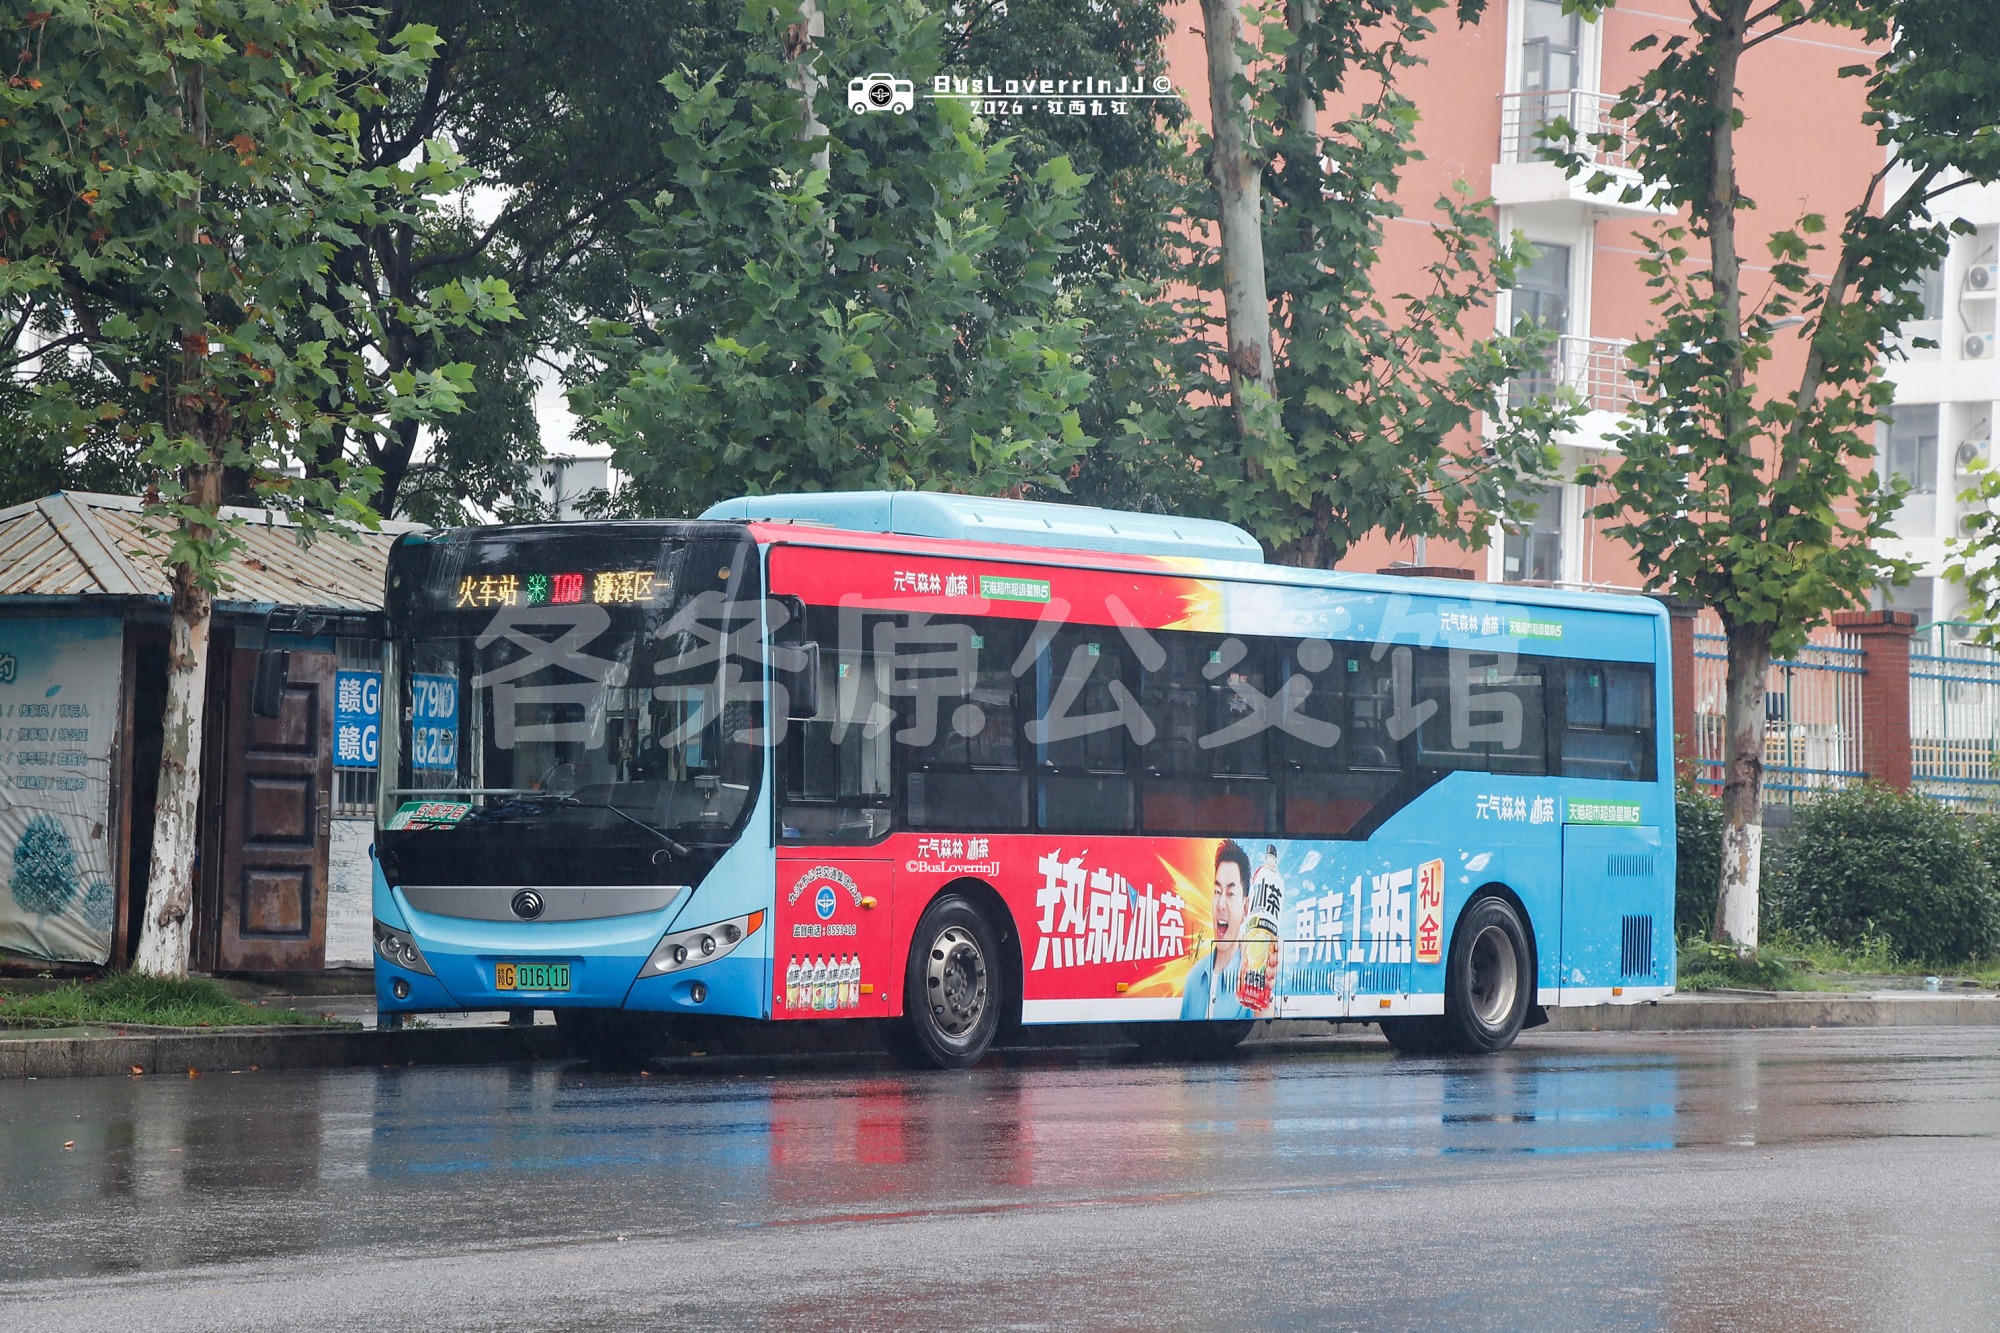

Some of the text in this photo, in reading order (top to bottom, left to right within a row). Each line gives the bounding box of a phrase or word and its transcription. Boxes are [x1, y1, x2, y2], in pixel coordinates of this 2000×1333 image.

[457, 574, 519, 607] 火车站
[552, 573, 583, 603] 108
[893, 571, 1049, 599] 元气森林 冰茶 天猫超市超级星期5
[1440, 612, 1479, 634] 元气森林
[1476, 794, 1640, 824] 元气森林 冰茶 天猫超市超级星期5
[917, 836, 989, 860] 元气森林 冰茶
[1031, 847, 1185, 971] 热就冰茶
[1294, 867, 1413, 964] 再来1瓶
[1418, 867, 1440, 955] 礼金
